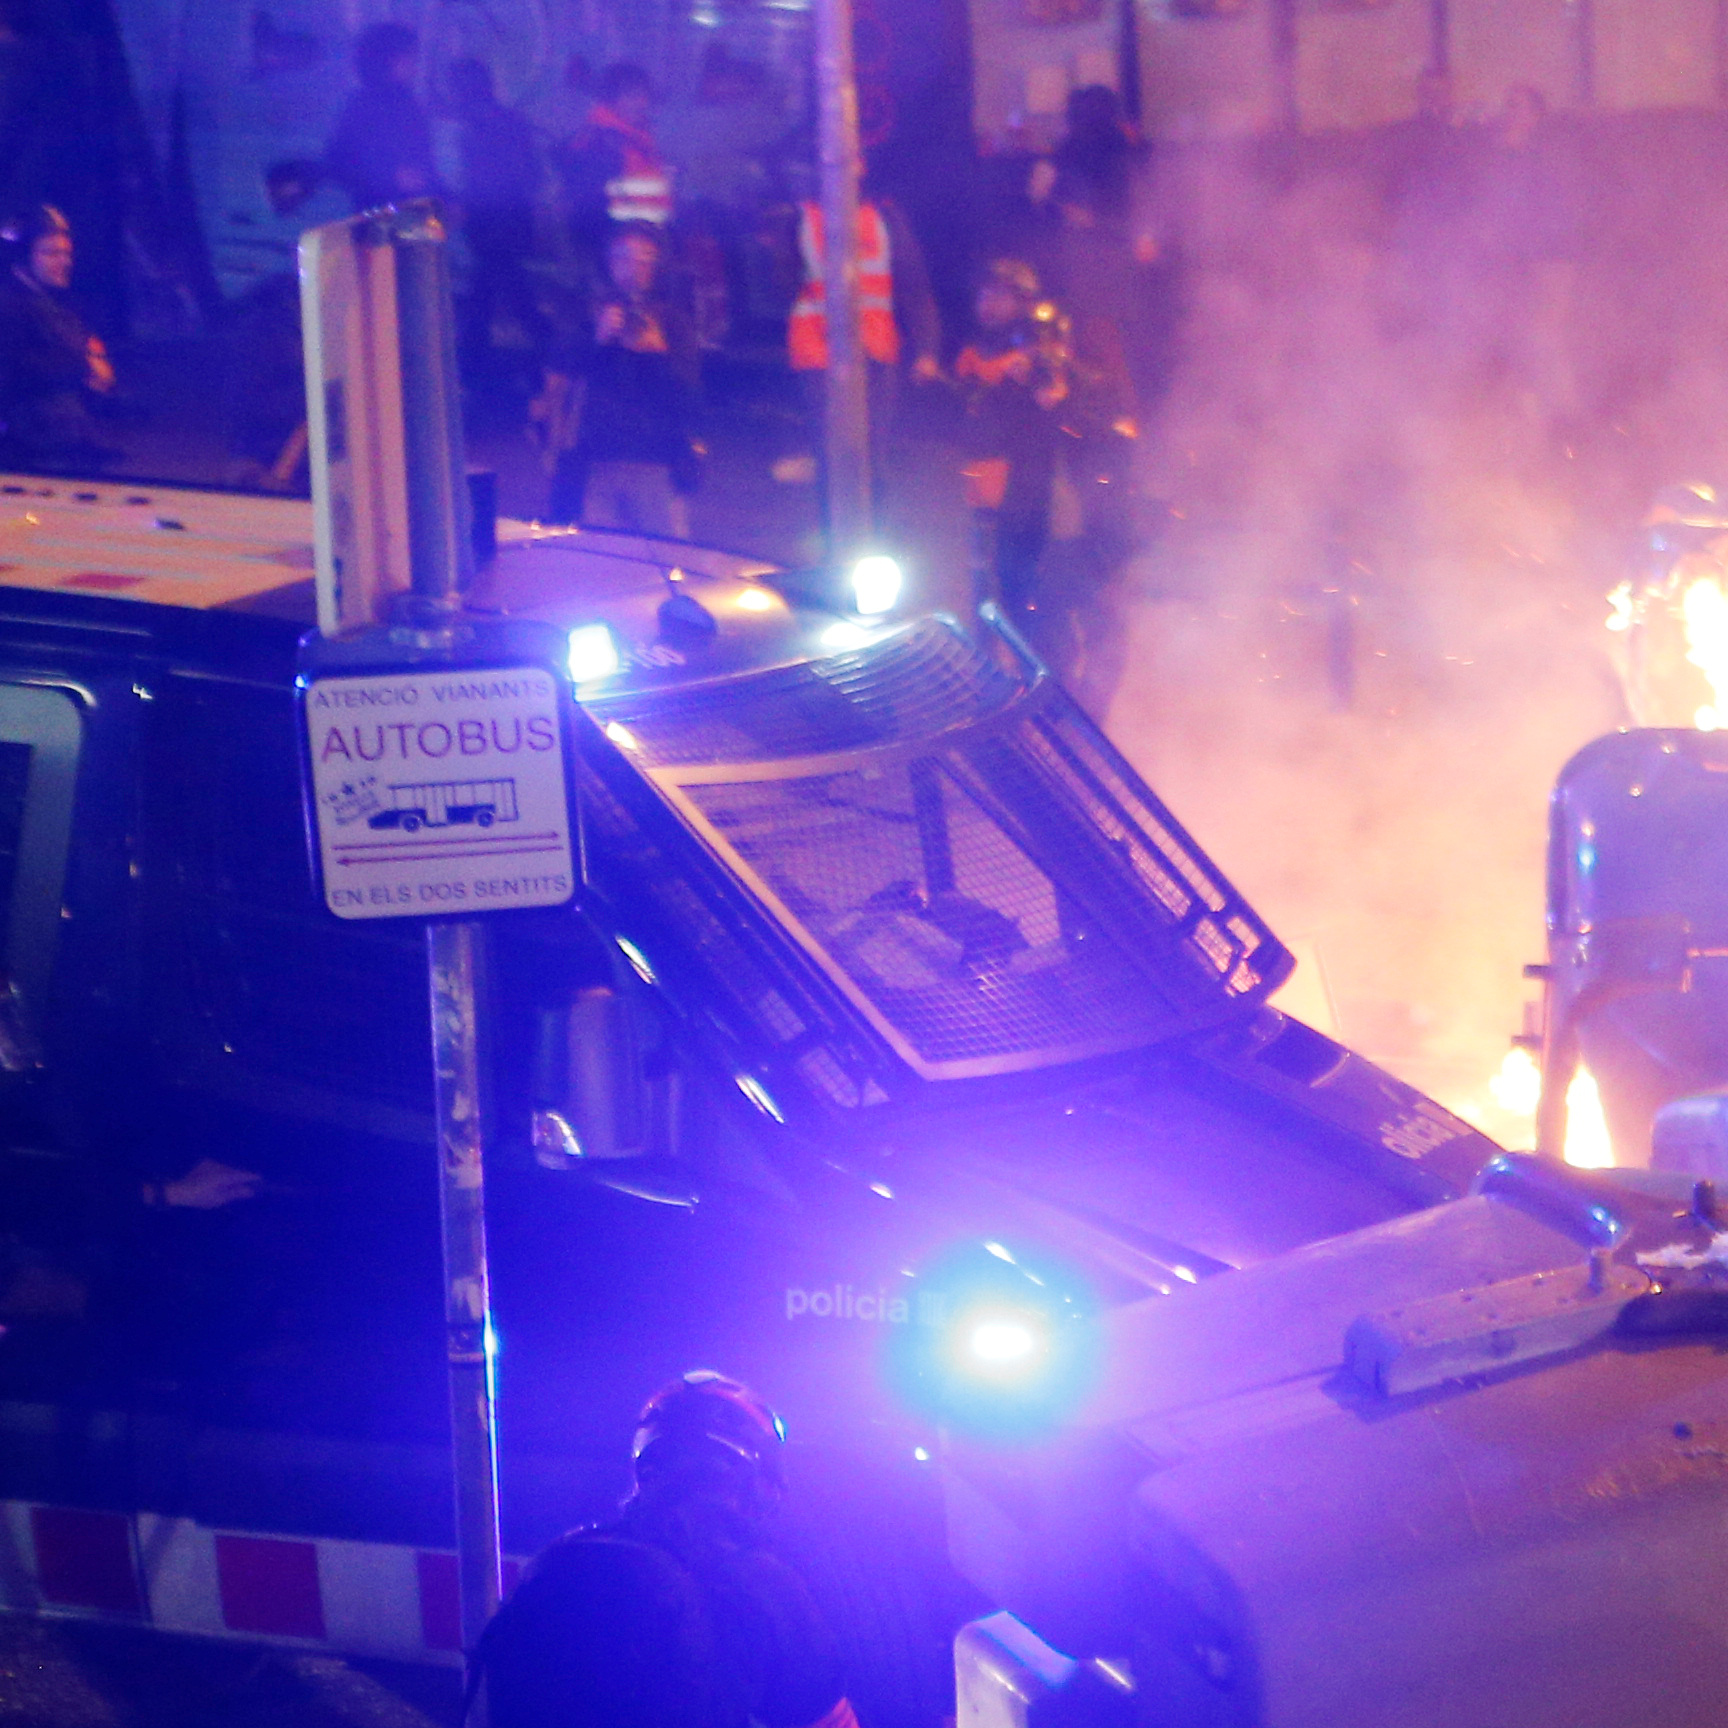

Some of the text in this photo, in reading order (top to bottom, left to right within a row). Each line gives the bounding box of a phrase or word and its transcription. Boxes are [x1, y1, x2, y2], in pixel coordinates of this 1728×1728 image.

[321, 717, 556, 762] AUTOBUS
[332, 875, 568, 907] EN ELS DOS SENTITS
[786, 1284, 909, 1324] policia
